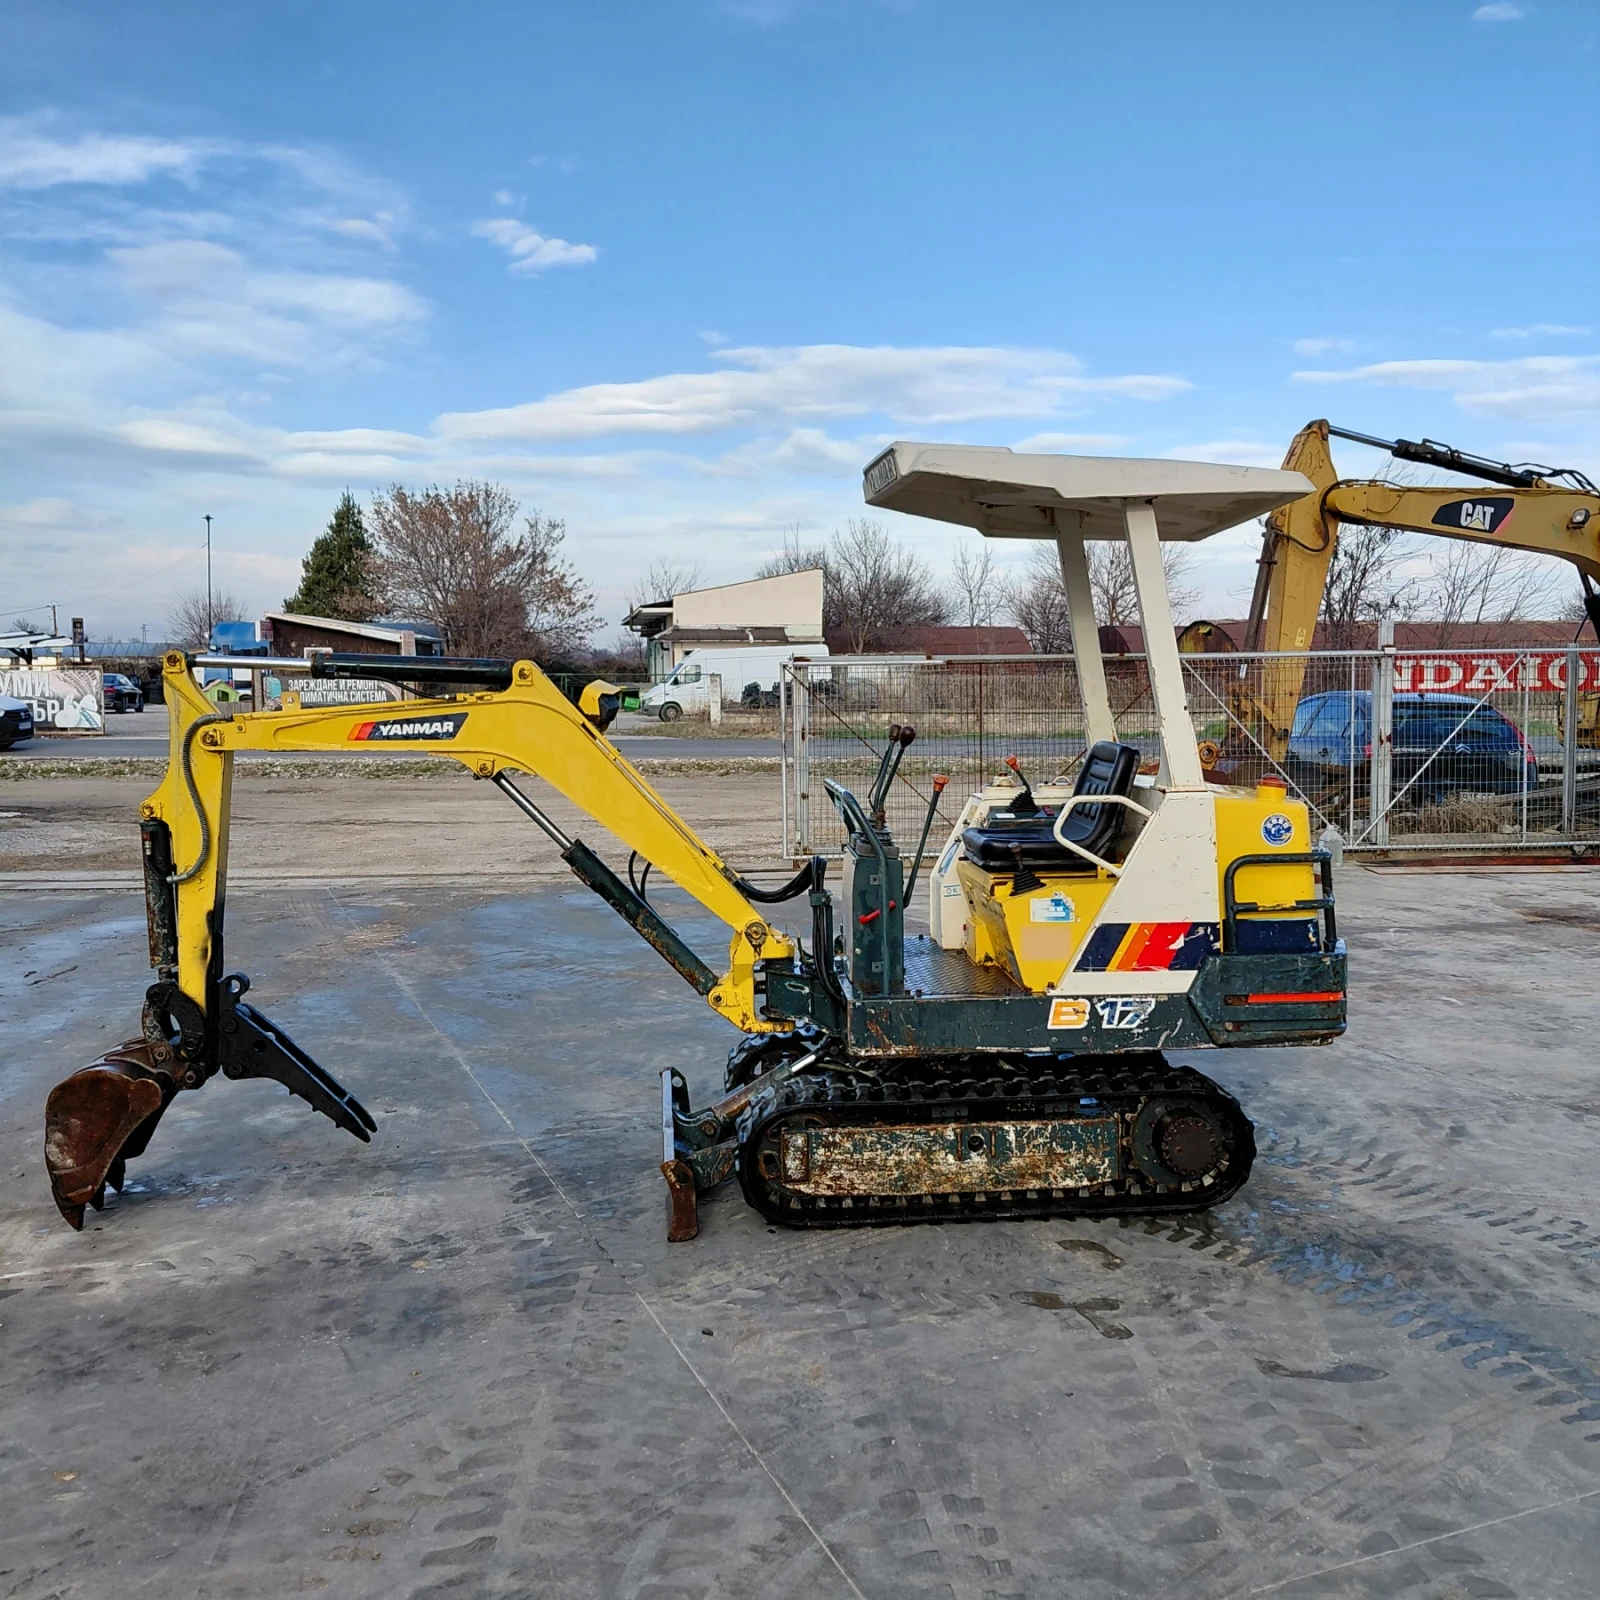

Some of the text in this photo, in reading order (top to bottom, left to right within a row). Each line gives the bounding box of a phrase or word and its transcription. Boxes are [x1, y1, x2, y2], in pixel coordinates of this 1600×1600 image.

[1460, 502, 1494, 531] CAT
[0, 671, 50, 697] УМИ
[288, 679, 378, 691] ЗАРЕЖДАНЕ И РЕМОНТ
[300, 690, 387, 703] ЛИМАТИЧНА СИСТЕМА
[379, 721, 454, 736] YANMAR
[946, 887, 959, 895] OK
